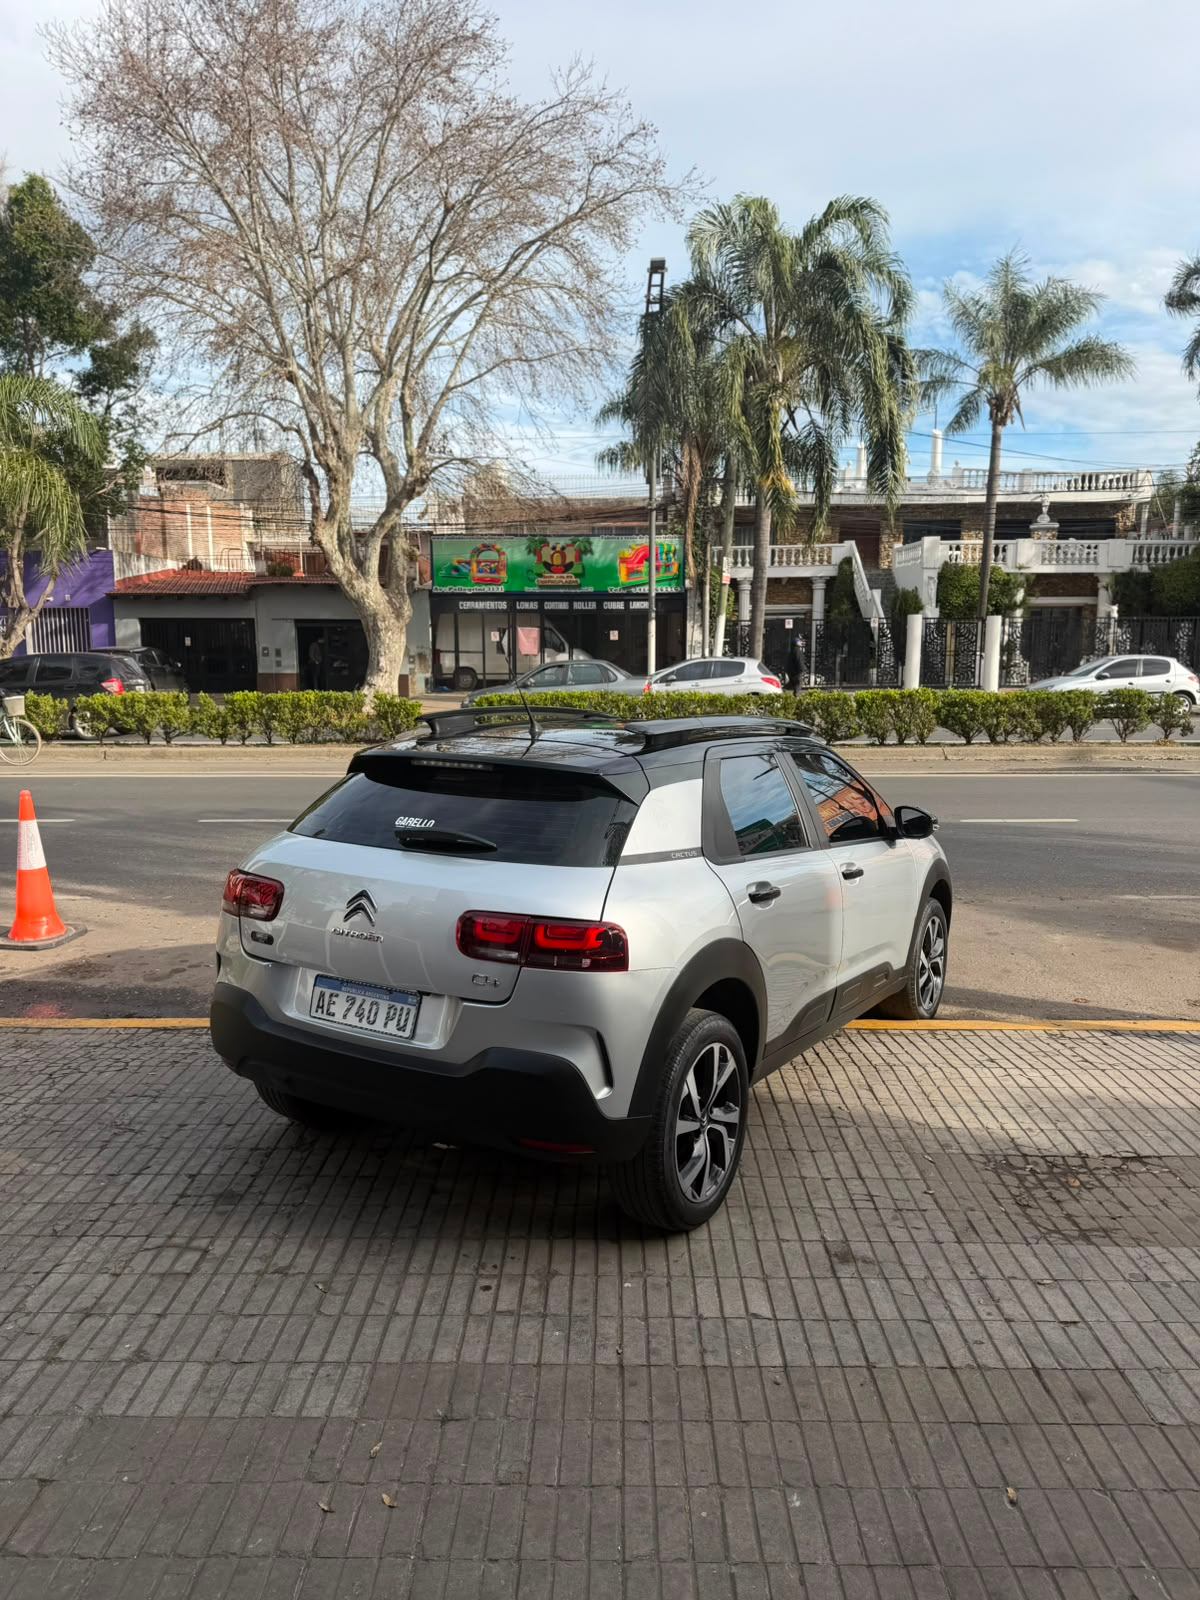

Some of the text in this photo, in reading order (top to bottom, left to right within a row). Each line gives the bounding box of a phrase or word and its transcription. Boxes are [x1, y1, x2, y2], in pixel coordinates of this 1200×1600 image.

[459, 601, 507, 610] CERRAMIENTOS
[516, 601, 539, 610] LONAS
[573, 601, 597, 610] ROLLER
[603, 601, 625, 610] CUBRE
[671, 850, 697, 859] CACTUS
[315, 990, 411, 1032] AE 740 PU
